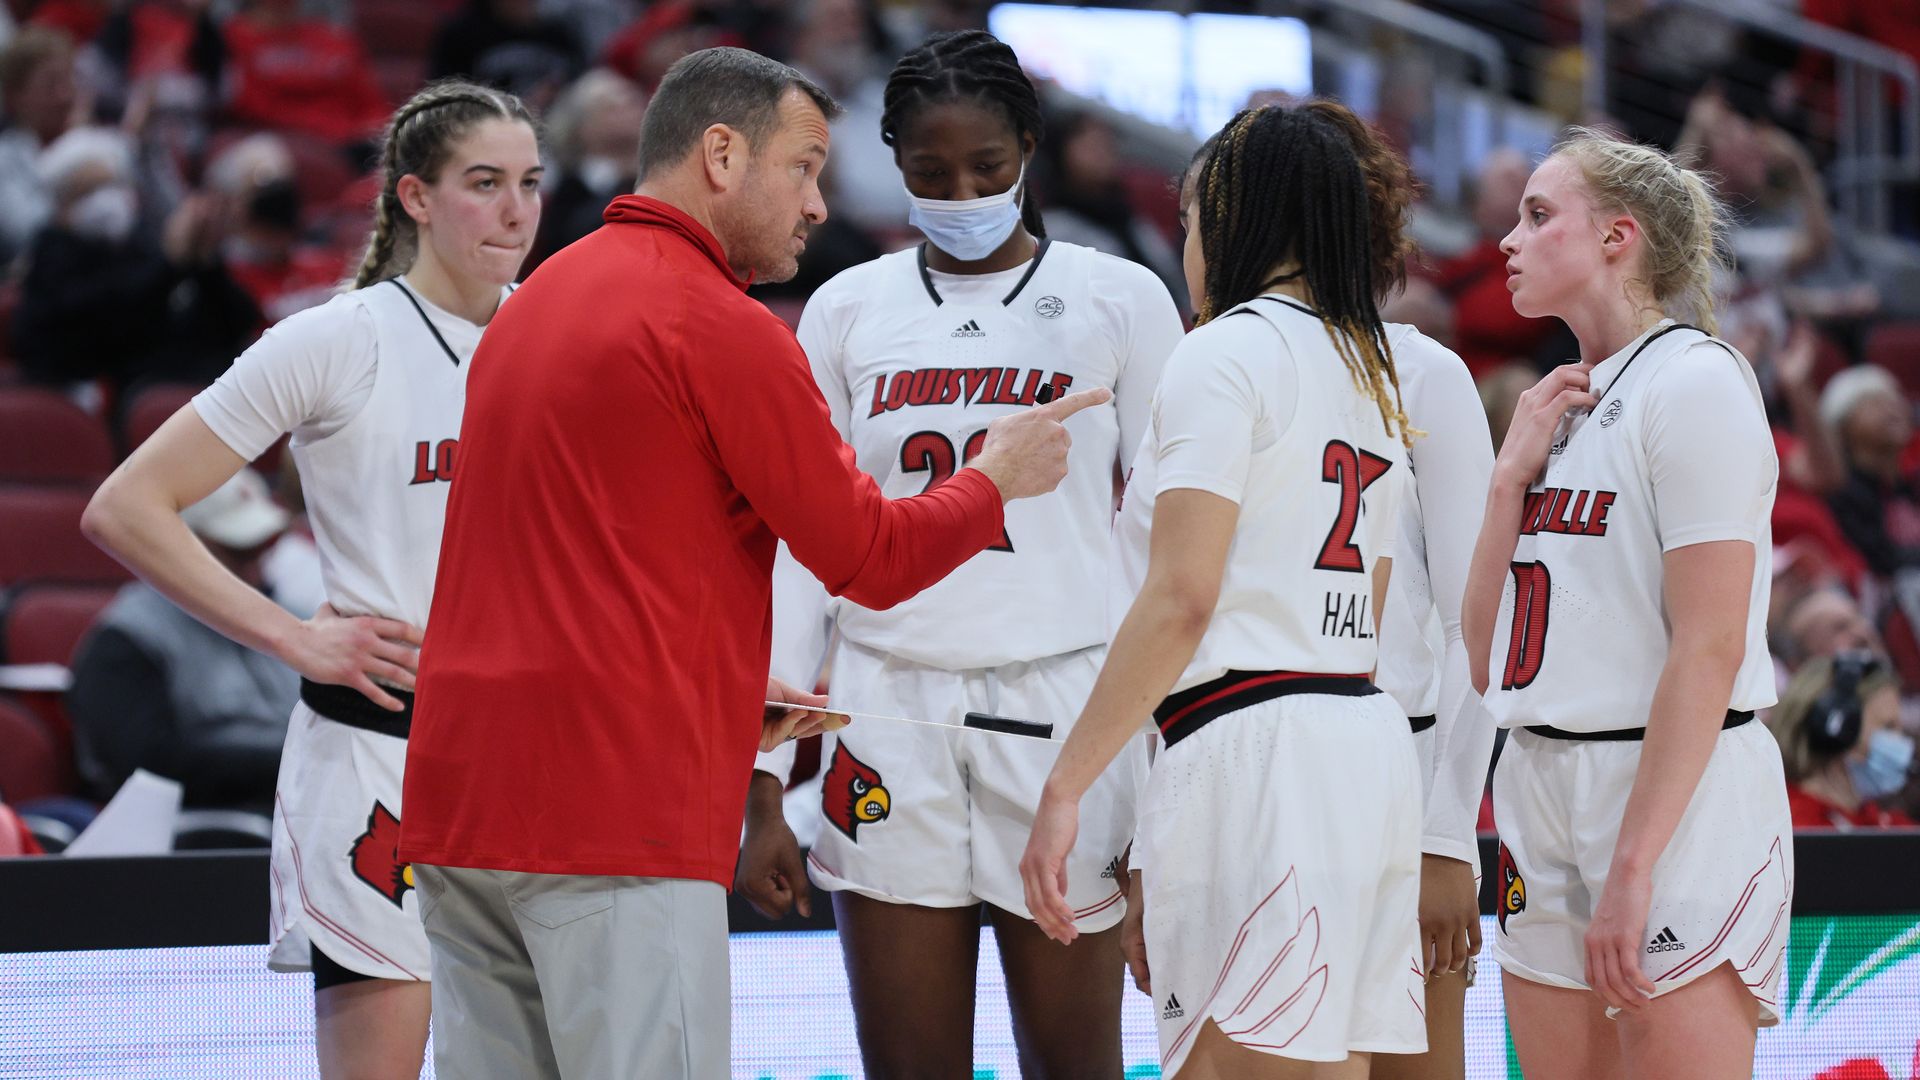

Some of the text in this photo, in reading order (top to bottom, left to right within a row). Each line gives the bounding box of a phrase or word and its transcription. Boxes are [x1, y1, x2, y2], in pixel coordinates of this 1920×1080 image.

[951, 330, 986, 338] adidas
[867, 367, 1074, 420] LOUISVILLE
[1646, 942, 1686, 954] adidas
